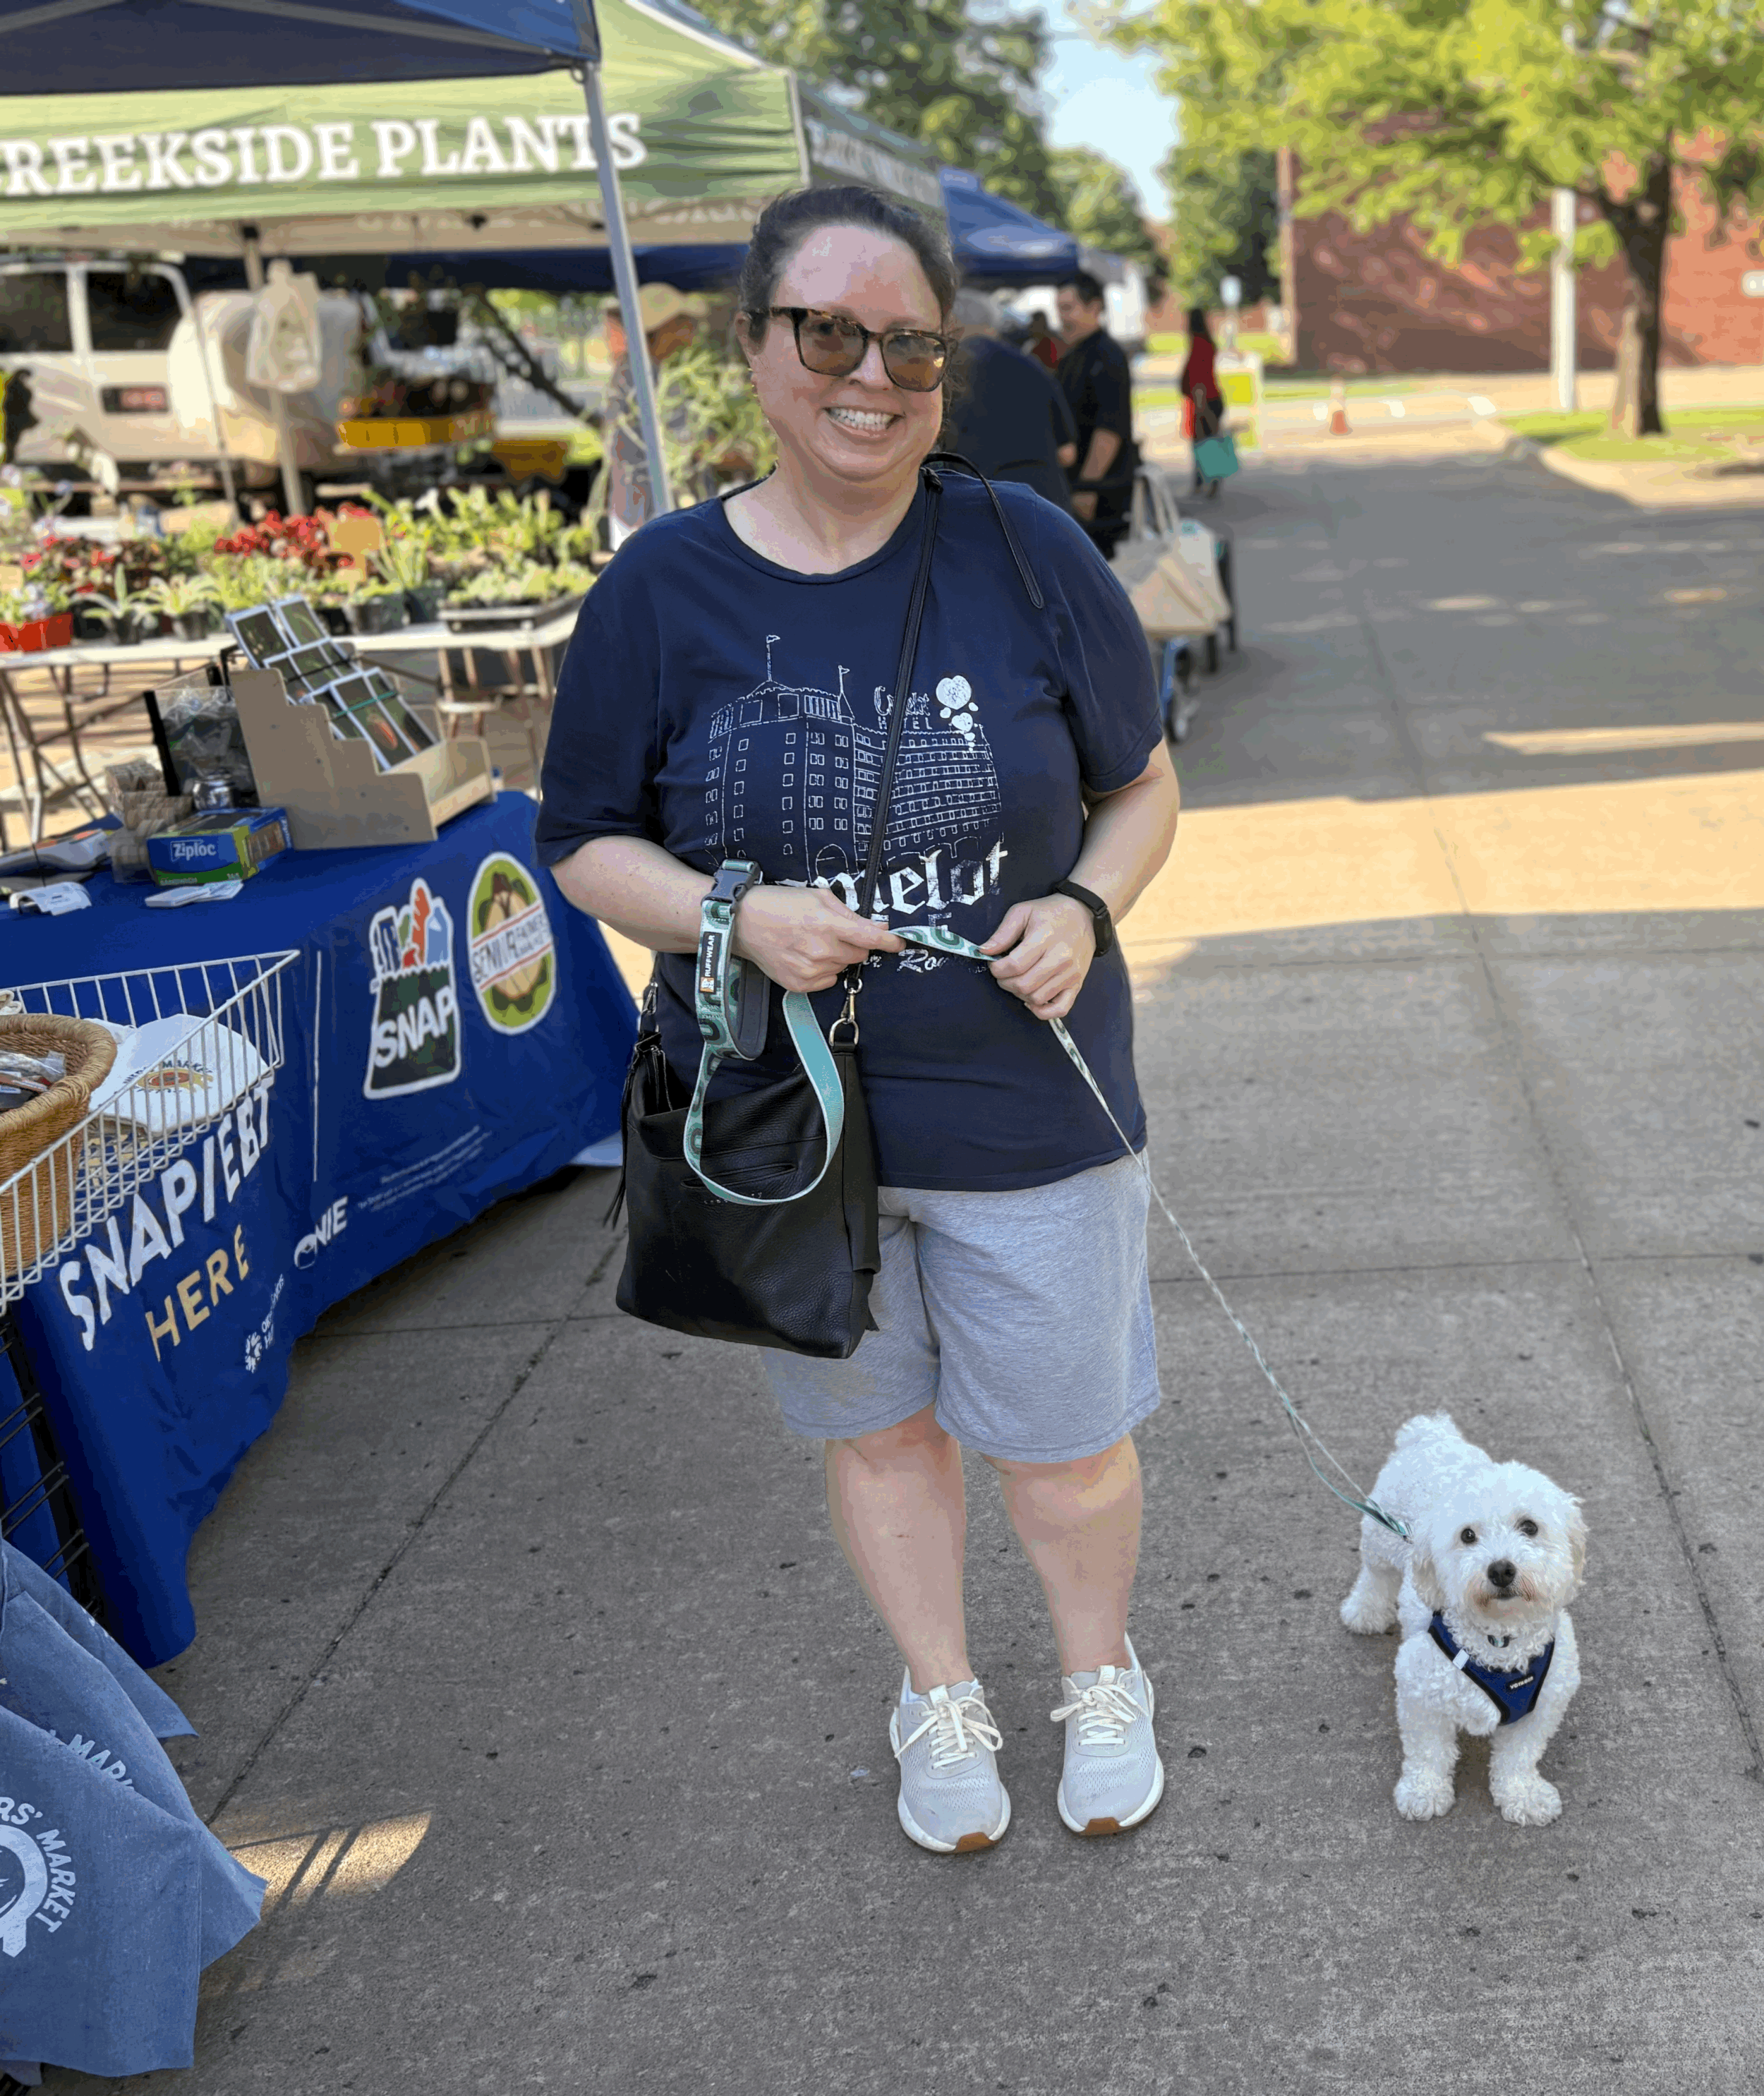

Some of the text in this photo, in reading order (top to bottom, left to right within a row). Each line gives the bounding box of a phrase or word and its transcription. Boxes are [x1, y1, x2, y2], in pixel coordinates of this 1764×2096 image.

[0, 113, 648, 196] REEKSIDE PLANTS
[877, 716, 933, 730] HTEL
[173, 841, 217, 862] Ziploc
[704, 934, 715, 977] RUFFWEAR
[373, 985, 455, 1068] SNAP
[145, 1224, 250, 1362] HERE
[68, 1733, 135, 1790] MAR
[35, 1829, 76, 1933] MARKET
